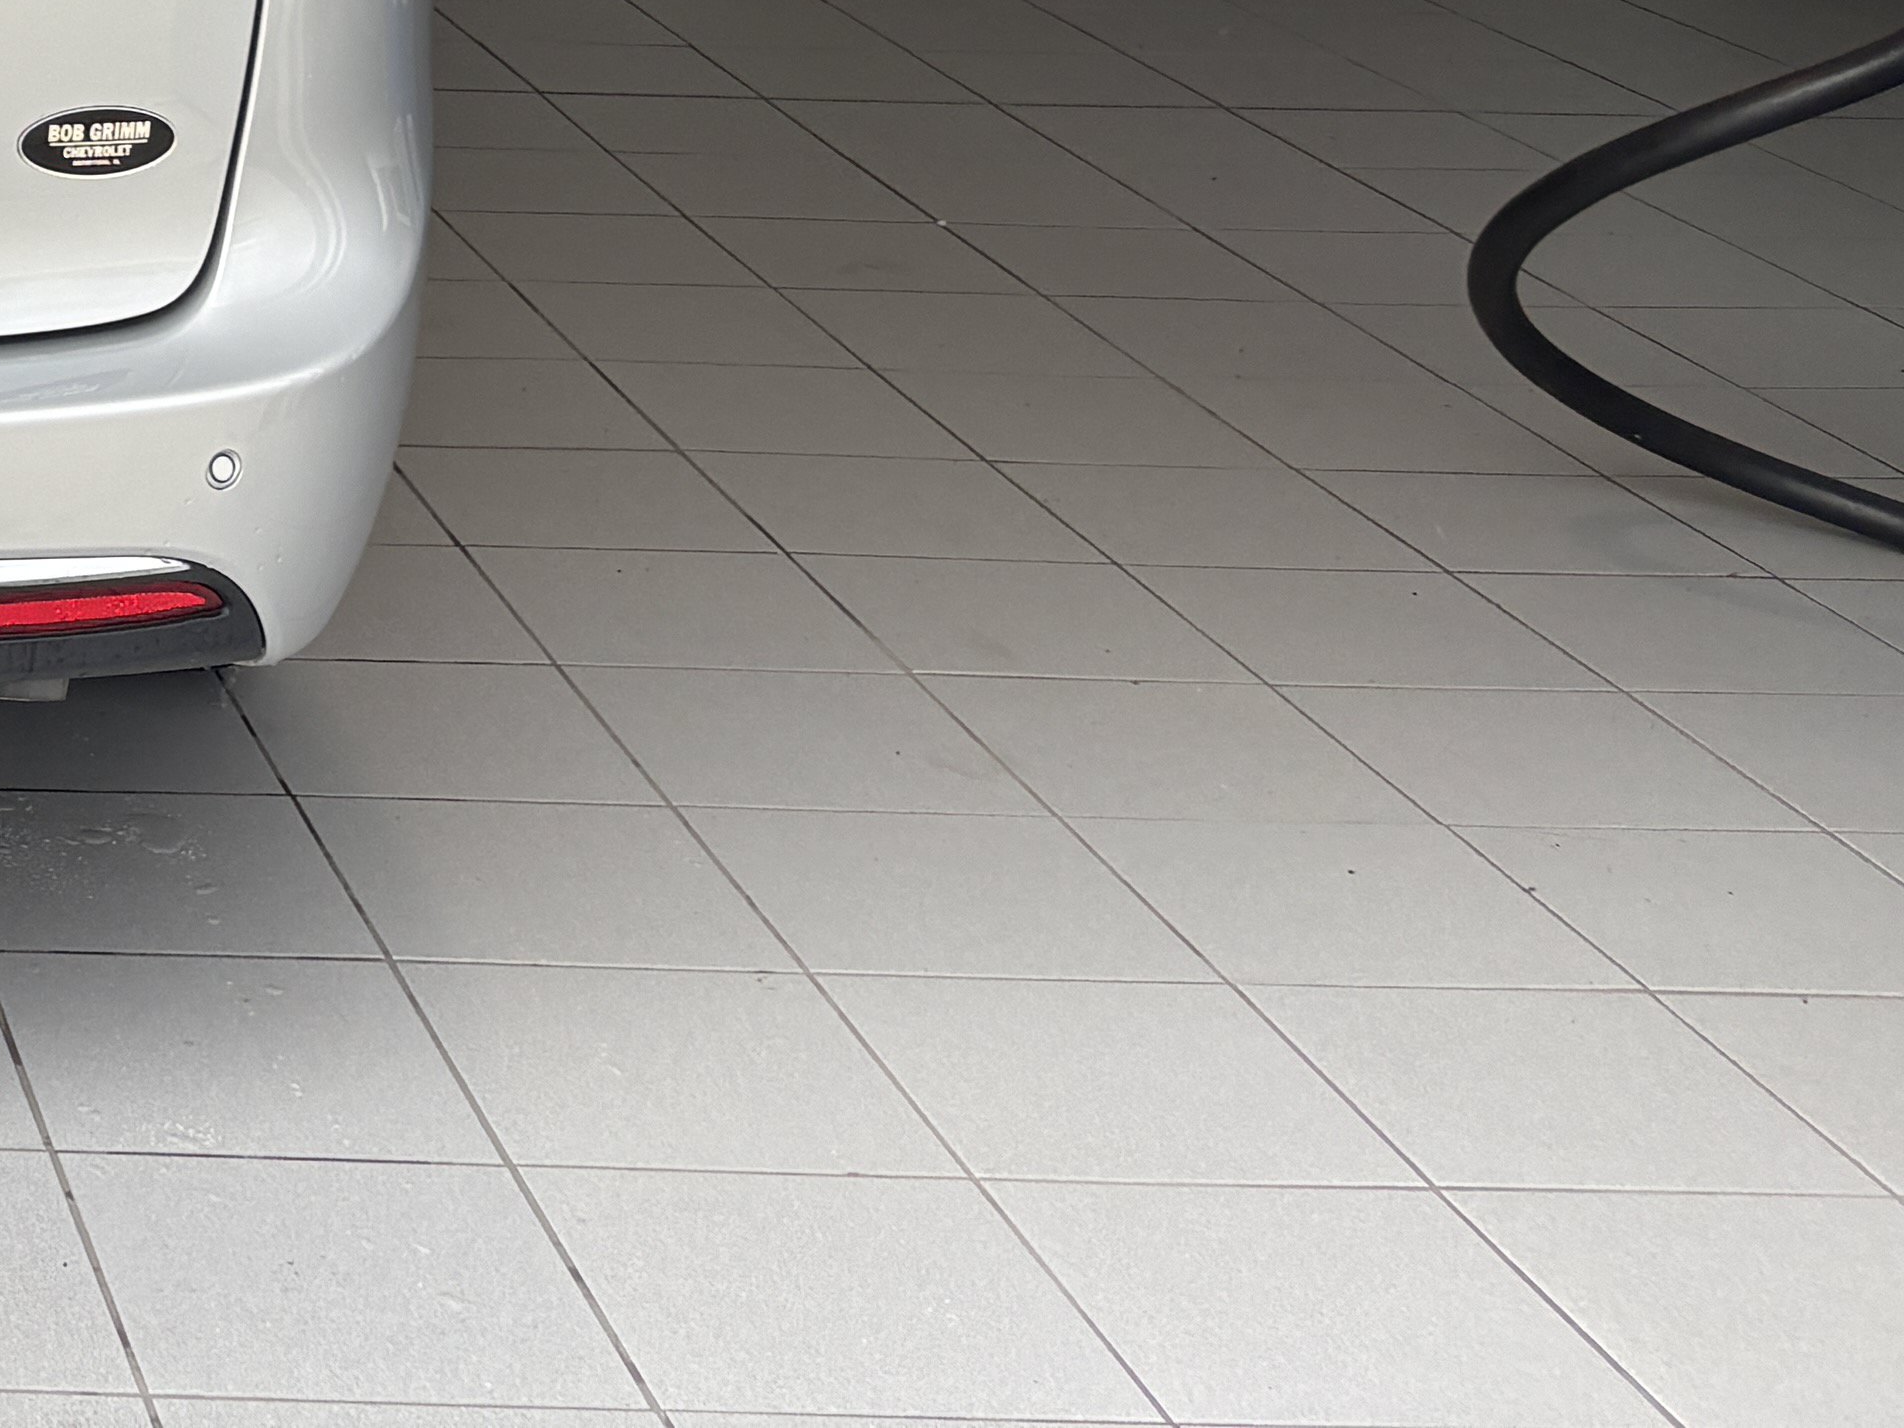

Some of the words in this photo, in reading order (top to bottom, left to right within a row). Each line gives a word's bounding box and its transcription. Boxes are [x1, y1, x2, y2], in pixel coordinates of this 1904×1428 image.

[47, 124, 85, 143] BOB
[89, 121, 152, 142] GRIMM
[62, 144, 133, 159] CHEVROLET
